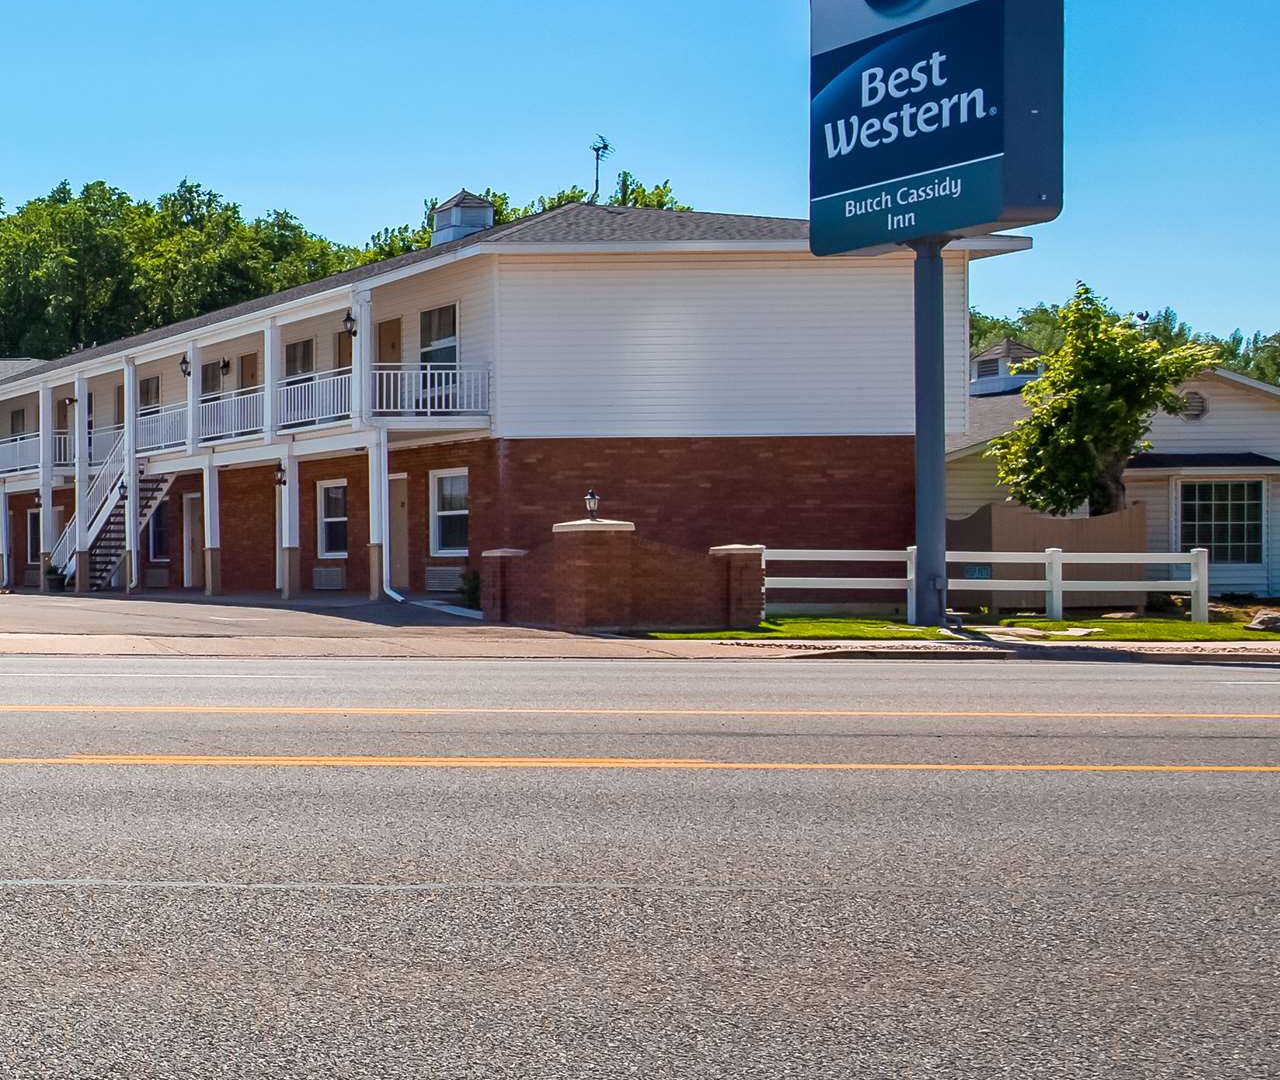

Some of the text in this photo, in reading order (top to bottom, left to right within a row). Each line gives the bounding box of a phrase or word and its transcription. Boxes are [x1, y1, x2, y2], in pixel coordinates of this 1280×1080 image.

[861, 51, 948, 108] Best
[845, 176, 962, 218] Butch Cassidy
[887, 211, 916, 231] Inn
